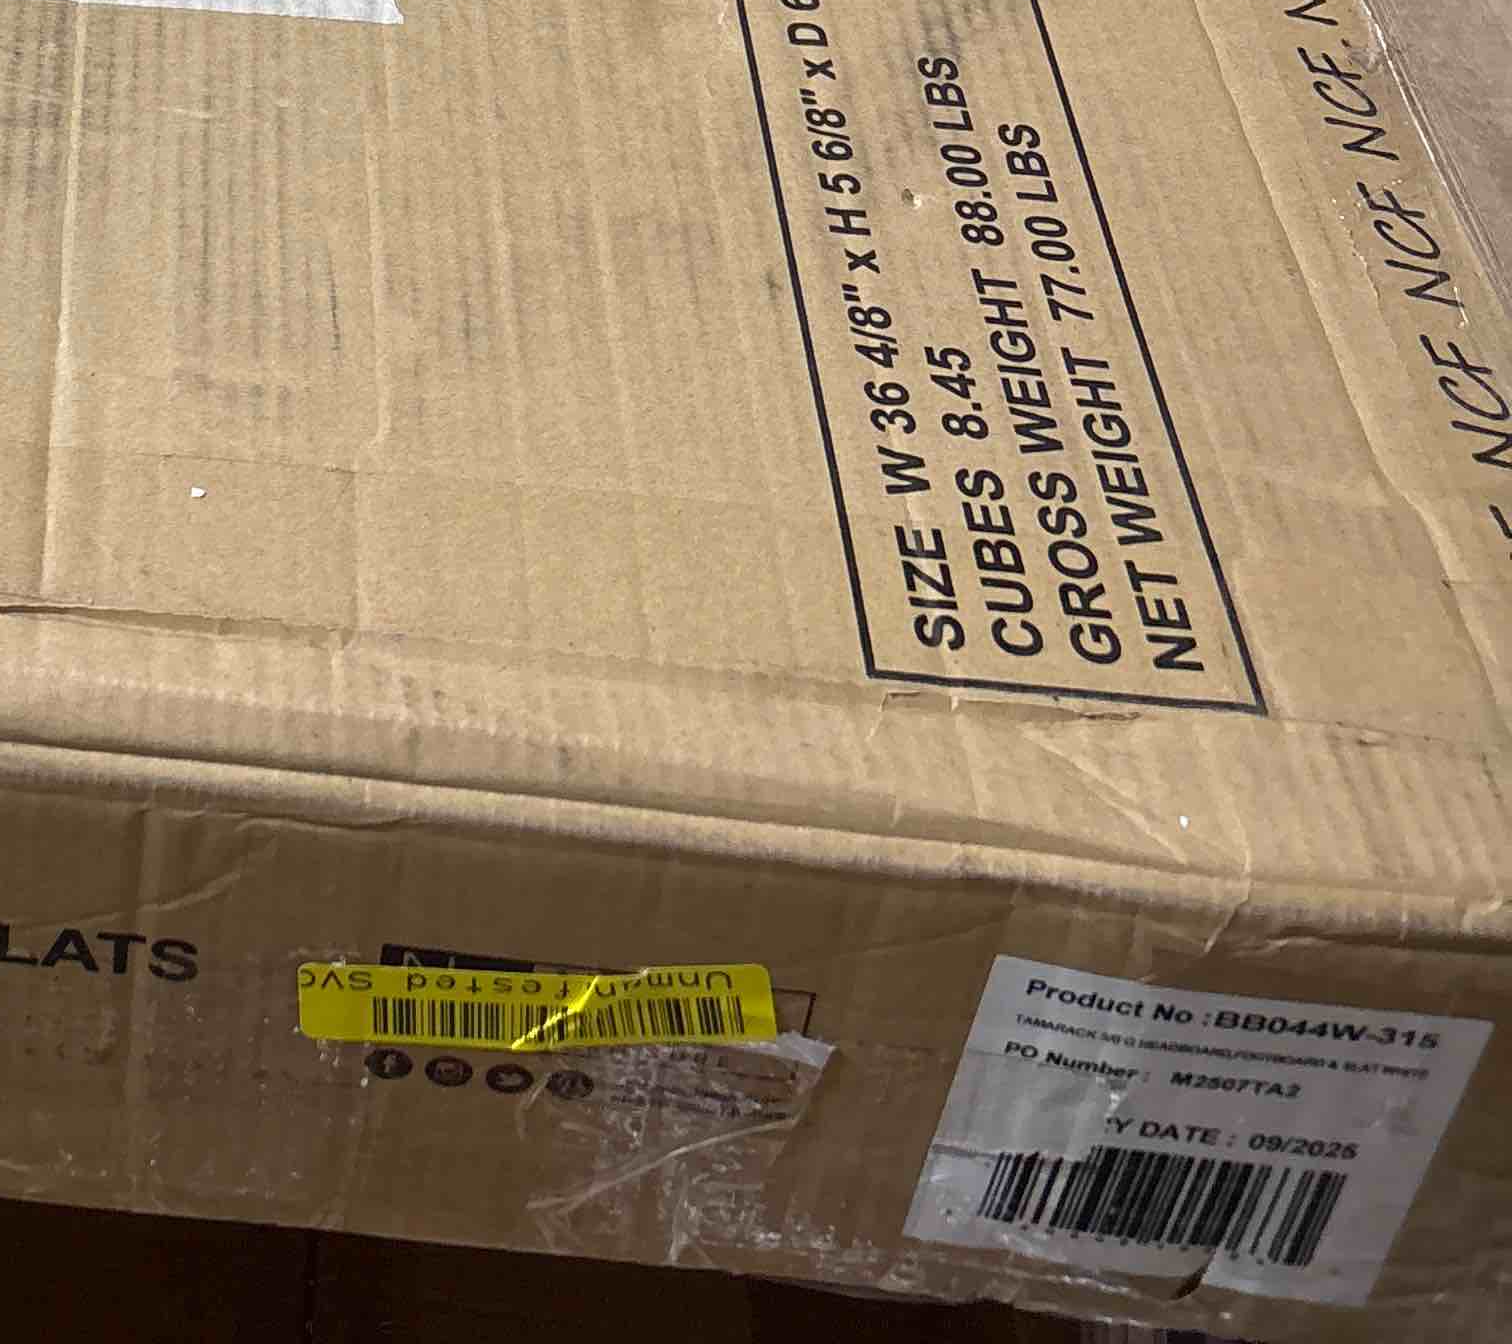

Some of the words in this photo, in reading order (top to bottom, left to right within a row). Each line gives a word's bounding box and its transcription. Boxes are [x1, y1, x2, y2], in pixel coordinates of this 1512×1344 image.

[787, 22, 829, 48] D
[802, 57, 836, 80] x
[799, 88, 854, 160] 6/8"
[917, 57, 974, 132] LBS
[817, 171, 861, 195] 5
[939, 143, 1004, 246] 88.00
[997, 123, 1058, 203] LBS
[824, 206, 871, 236] H
[1356, 181, 1465, 308] NCF
[844, 248, 881, 274] x
[1024, 215, 1094, 321] 77.00
[842, 283, 900, 369] 4/8"
[971, 268, 1064, 454] WEIGHT
[863, 381, 916, 435] 36
[924, 345, 989, 440] 8.45
[876, 444, 931, 495] W
[1061, 346, 1164, 546] WEIGHT
[895, 525, 965, 651] SIZE
[955, 468, 1044, 657] CUBES
[1028, 471, 1122, 665] GROSS
[1124, 559, 1205, 672] NET
[1015, 1014, 1097, 1040] TAMARACK
[1026, 979, 1145, 1018] Product
[1153, 1002, 1194, 1024] No
[1004, 1040, 1039, 1060] PO
[1045, 1051, 1140, 1079] Number
[1138, 1119, 1222, 1147] DATE
